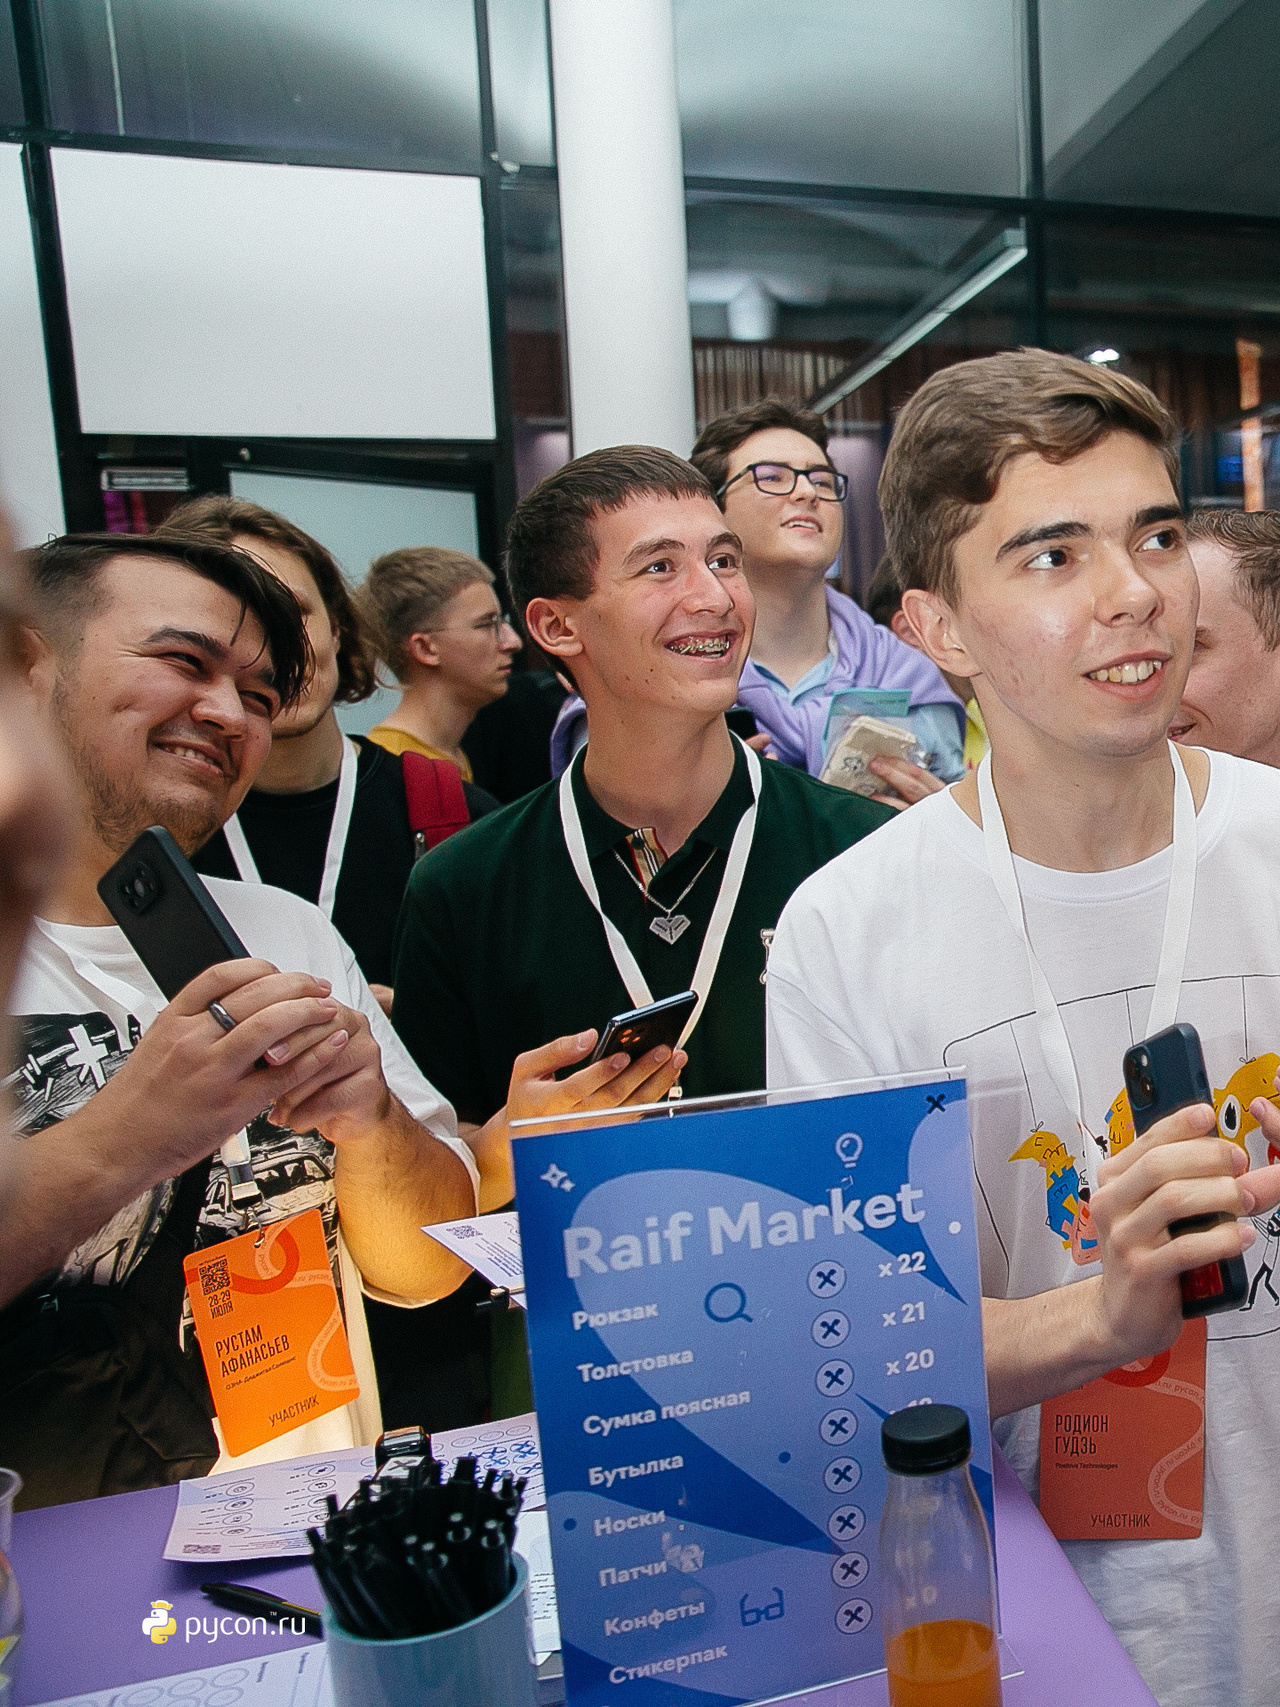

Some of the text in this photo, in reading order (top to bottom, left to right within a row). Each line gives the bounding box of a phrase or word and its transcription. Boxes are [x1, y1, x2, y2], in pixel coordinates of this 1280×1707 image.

[563, 1210, 695, 1279] Raif
[707, 1182, 926, 1256] Market
[897, 1250, 928, 1275] 22
[208, 1289, 231, 1308] 28-29
[210, 1301, 233, 1319] ИЮЛЯ
[901, 1300, 927, 1325] 21
[572, 1303, 660, 1332] Рюкзак
[215, 1324, 263, 1358] РУСТАМ
[221, 1334, 290, 1378] АФАНАСЬЕВ
[576, 1349, 696, 1384] Толстовка
[905, 1348, 936, 1373] 20
[268, 1394, 320, 1427] УЧАСТНИК
[582, 1390, 751, 1437] Сумка поясная
[1055, 1414, 1109, 1435] РОДИОН
[1055, 1436, 1097, 1457] ГУДЗЬ
[587, 1455, 684, 1488] Бутылка
[1055, 1462, 1119, 1471] Positive Technologies
[593, 1510, 666, 1537] Носки
[1090, 1513, 1151, 1528] УЧАСТНИК
[599, 1560, 668, 1588] Патчи
[603, 1601, 706, 1637] Конфеты
[609, 1645, 728, 1684] Стикерпак
